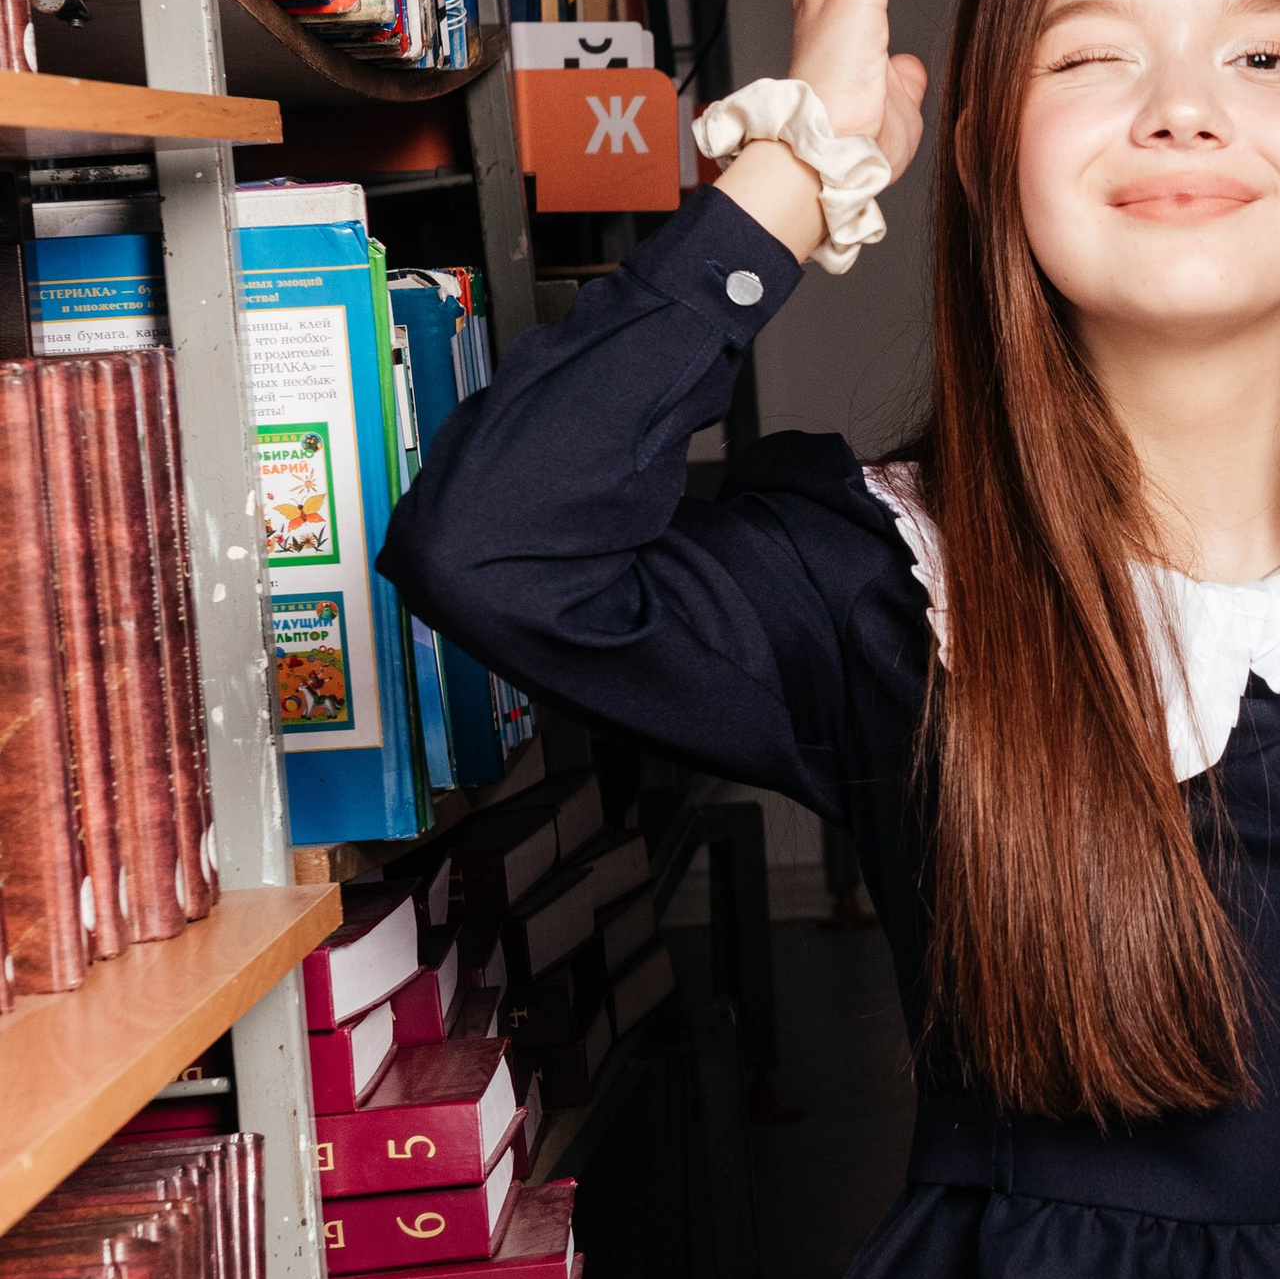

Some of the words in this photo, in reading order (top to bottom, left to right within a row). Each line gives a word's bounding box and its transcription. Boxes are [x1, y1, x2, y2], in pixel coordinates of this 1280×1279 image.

[584, 95, 649, 155] Ж
[277, 277, 323, 288] эмоций
[62, 305, 70, 313] и
[73, 301, 144, 312] множество
[299, 319, 331, 330] клей
[77, 330, 130, 344] бумага,
[255, 337, 278, 346] что
[281, 333, 333, 344] необхо-
[254, 351, 262, 360] и
[265, 347, 334, 363] родителей.
[283, 375, 336, 387] необык-
[298, 389, 338, 402] порой
[277, 631, 329, 645] ЛЬПТОР
[387, 1135, 436, 1159] 5
